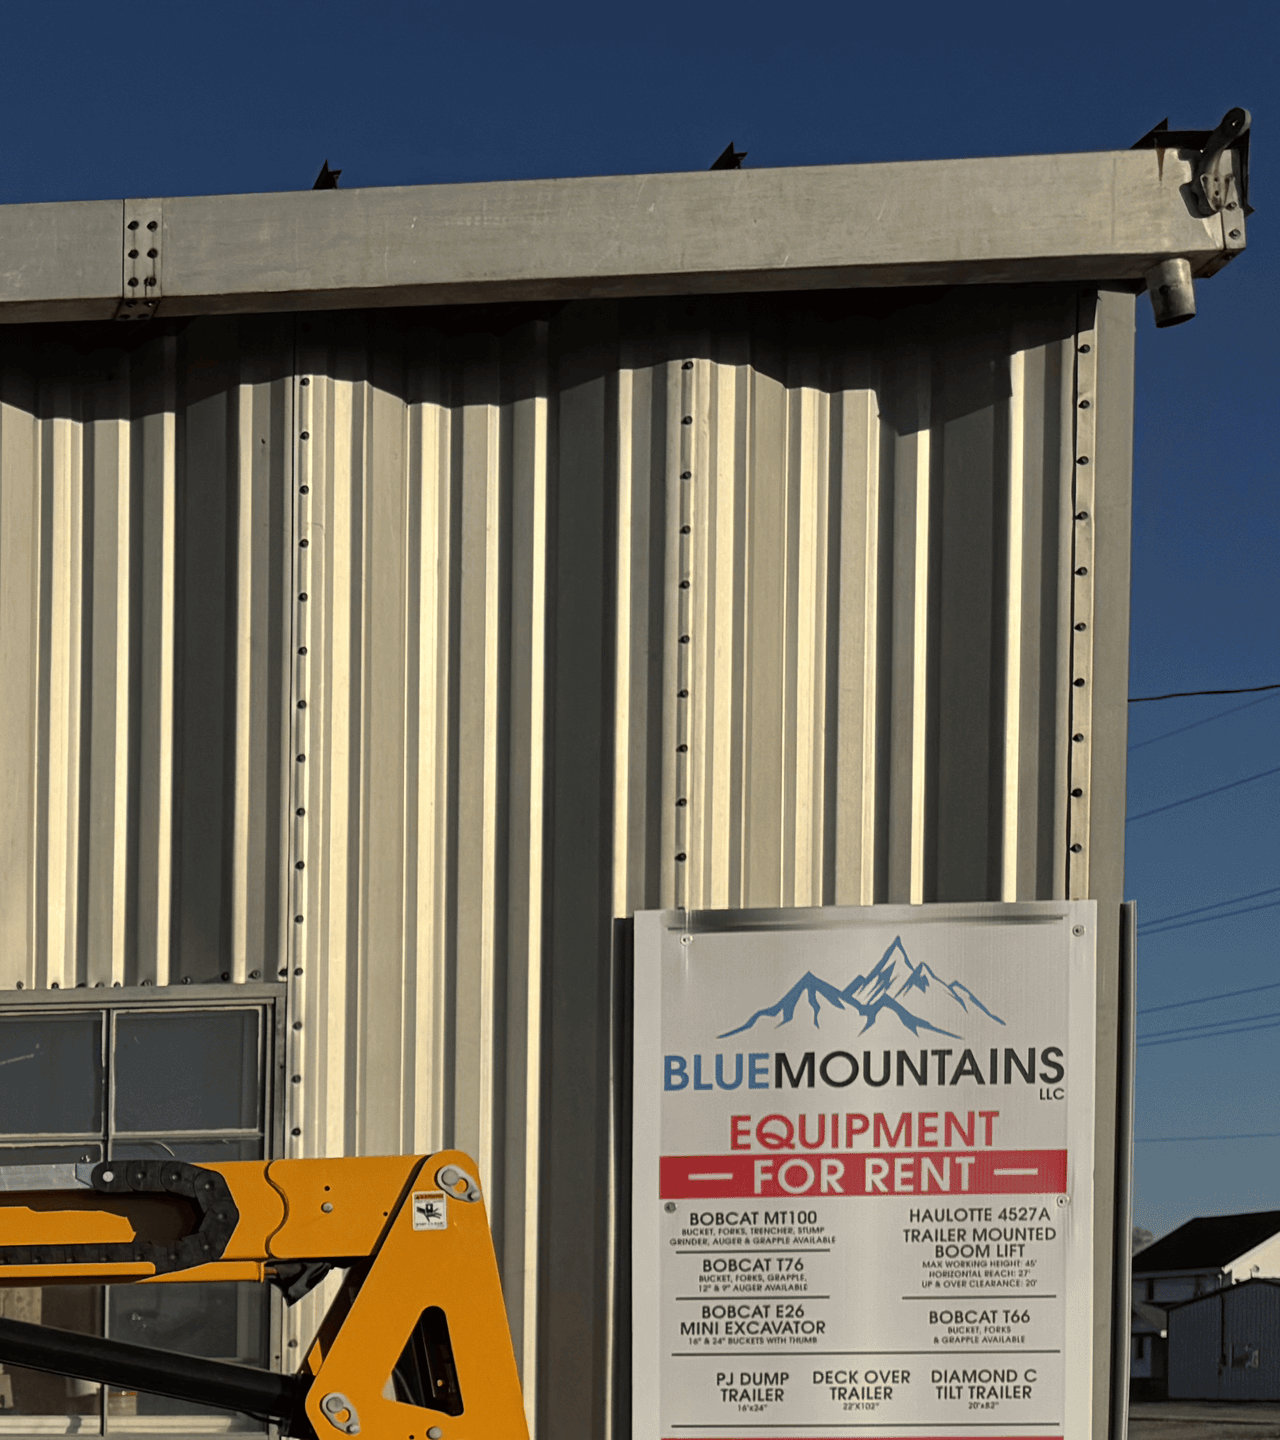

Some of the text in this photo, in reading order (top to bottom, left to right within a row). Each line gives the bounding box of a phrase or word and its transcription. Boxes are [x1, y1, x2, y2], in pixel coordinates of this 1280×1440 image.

[663, 1047, 1065, 1091] BLUEMOUNTAINS
[1040, 1088, 1064, 1100] LLC
[730, 1110, 1000, 1151] EQUIPMENT
[754, 1157, 975, 1194] FOR RENT
[690, 1211, 817, 1226] BOBCAT MT100
[910, 1207, 1050, 1222] HAULOTTE 4527A
[793, 1236, 835, 1244] AVAILABLE
[903, 1227, 1056, 1242] TRAILER MOUNTED
[936, 1244, 1025, 1258] BOOM LIFT
[703, 1258, 803, 1272] BOBCAT T76
[733, 1284, 762, 1292] AUGER
[943, 1280, 966, 1288] OVER
[702, 1305, 804, 1319] BOBCAT E26
[930, 1310, 1030, 1324] BOBCAT T66
[681, 1321, 825, 1335] MINI EXCAVATOR
[942, 1336, 979, 1344] GRAPPLE
[717, 1372, 789, 1386] PJ DUMP
[813, 1369, 911, 1385] DECK OVER
[932, 1369, 1037, 1383] DIAMOND C
[721, 1388, 784, 1402] TRAILER
[829, 1386, 893, 1400] TRAILER
[936, 1385, 1032, 1399] TILT TRAILER
